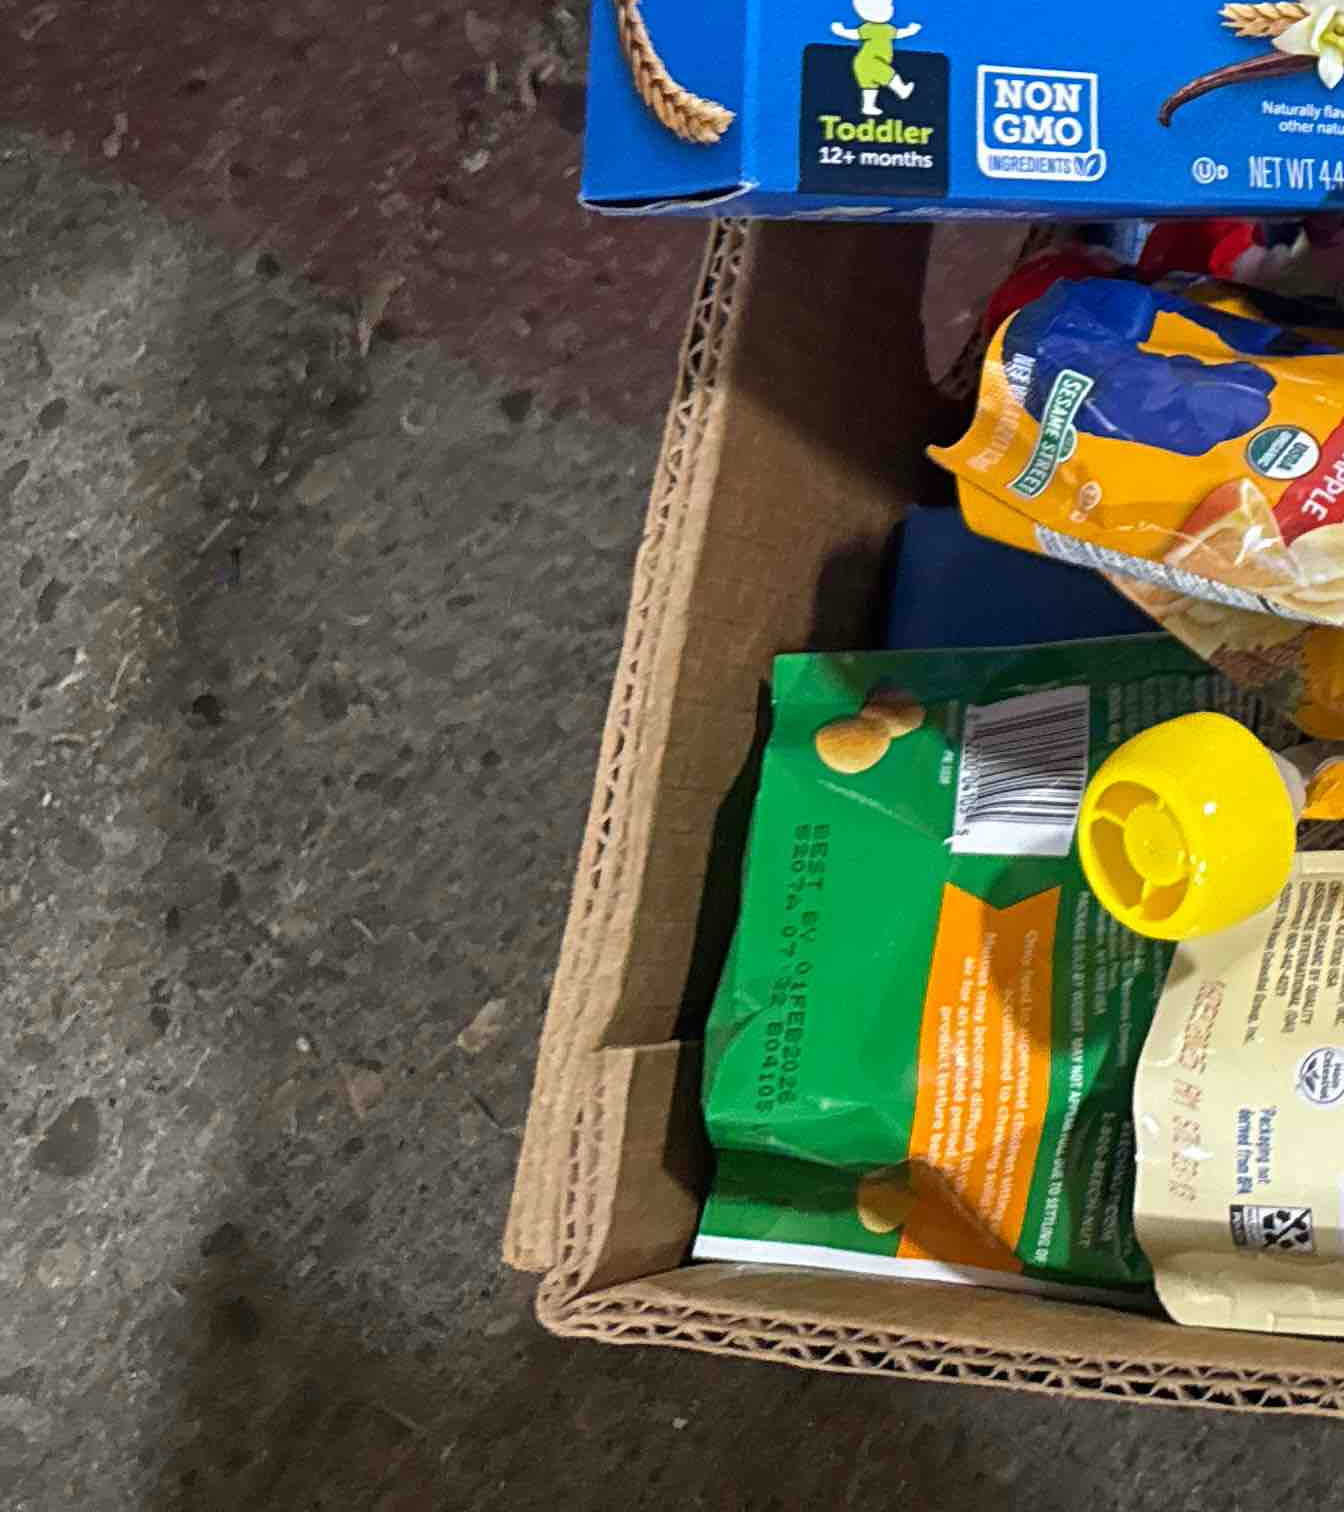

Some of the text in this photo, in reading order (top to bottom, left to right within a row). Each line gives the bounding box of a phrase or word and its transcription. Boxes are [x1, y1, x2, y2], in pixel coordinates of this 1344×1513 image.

[994, 77, 1082, 112] NON
[820, 115, 933, 147] Toddler
[994, 114, 1083, 148] GMO
[818, 147, 933, 169] 12+ months
